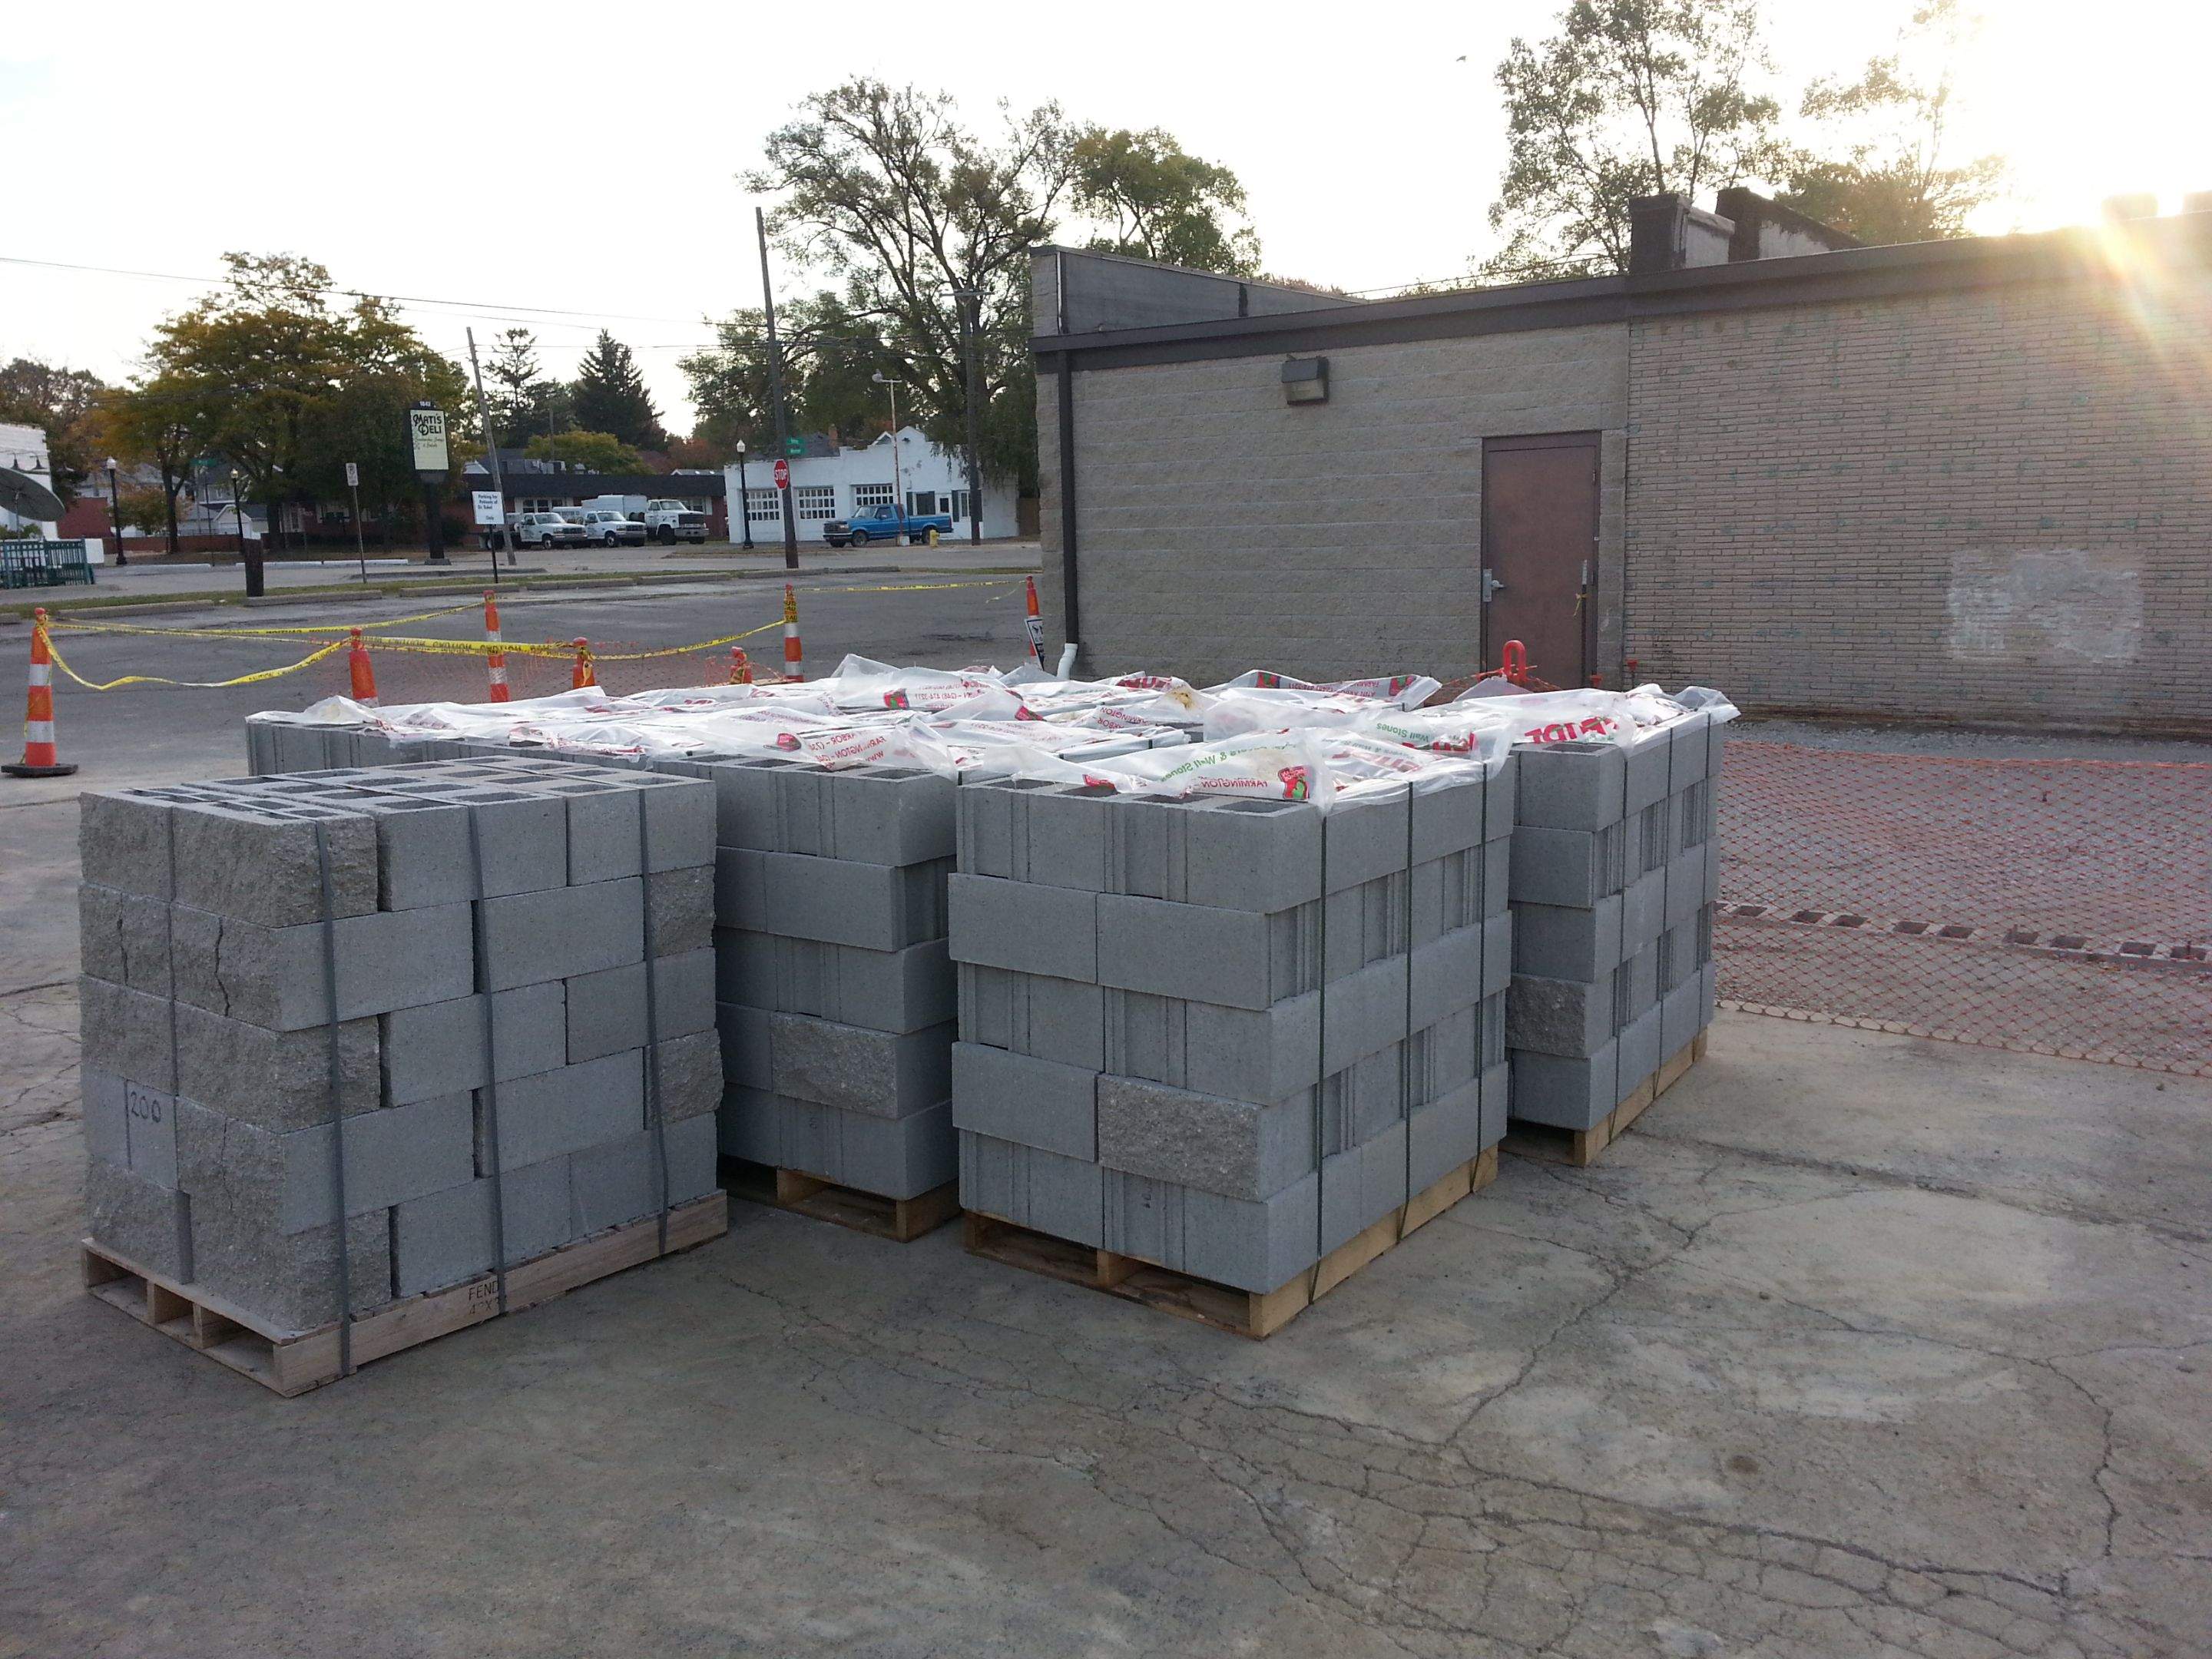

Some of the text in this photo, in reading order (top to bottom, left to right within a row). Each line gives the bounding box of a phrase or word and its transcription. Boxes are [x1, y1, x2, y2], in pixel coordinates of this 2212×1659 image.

[418, 423, 442, 436] DELI
[774, 469, 787, 481] STOP
[1376, 723, 1408, 738] Stones
[131, 1091, 161, 1124] 200
